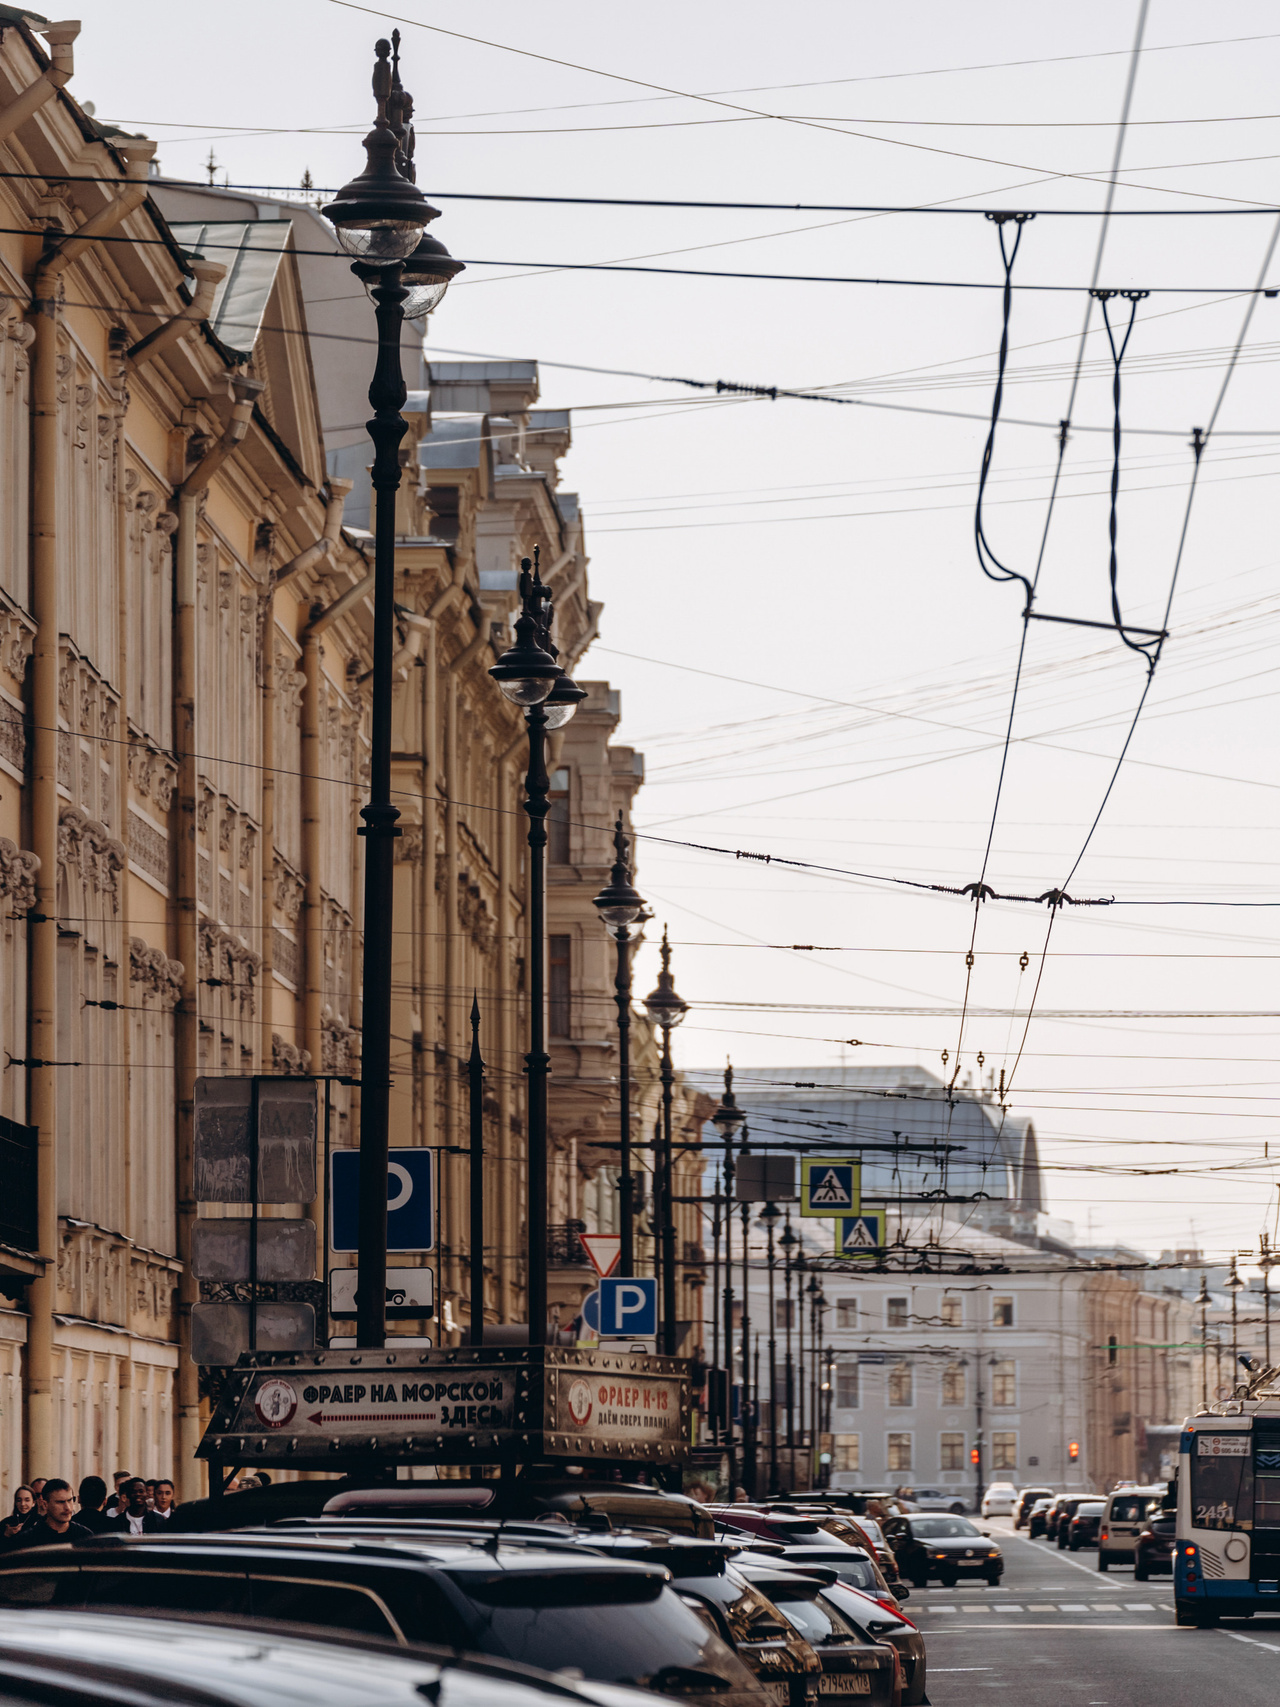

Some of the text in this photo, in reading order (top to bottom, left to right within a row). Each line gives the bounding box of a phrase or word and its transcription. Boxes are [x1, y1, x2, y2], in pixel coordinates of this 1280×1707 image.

[615, 1285, 646, 1329] P
[302, 1378, 503, 1403] ФРАЕР НА МОРСКОЙ
[598, 1385, 668, 1411] ФРАЕР К-13
[440, 1405, 503, 1428] ЗДЕСЬ
[598, 1409, 670, 1429] ДАЁМ СВЕРХ ПЛАНА!
[1196, 1505, 1235, 1519] 2451
[759, 1650, 781, 1665] Jeep
